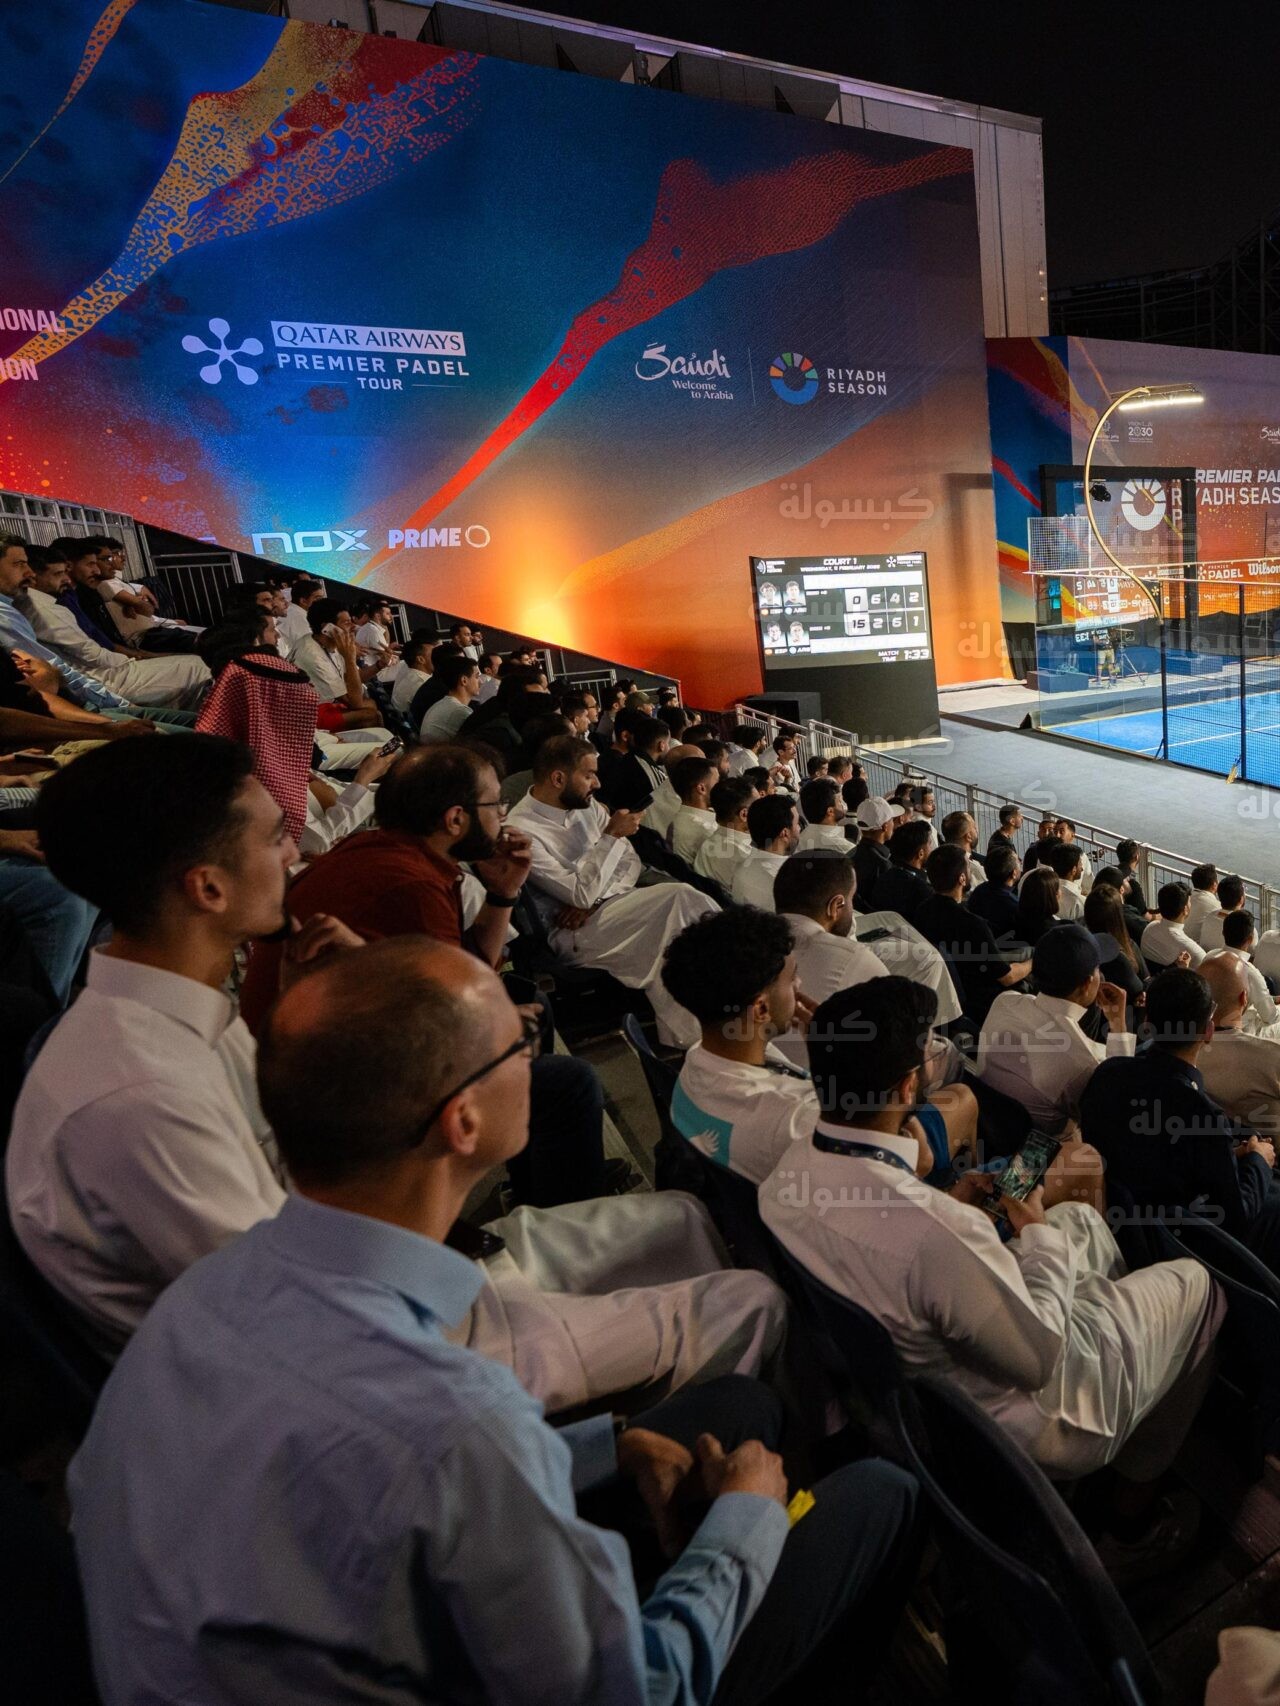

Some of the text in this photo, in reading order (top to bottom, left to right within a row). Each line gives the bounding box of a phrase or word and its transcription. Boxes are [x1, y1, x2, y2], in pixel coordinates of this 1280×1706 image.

[277, 325, 461, 351] QATAR AIRWAYS
[277, 353, 470, 376] PREMIER PADEL
[635, 342, 732, 380] Saudi
[827, 368, 887, 382] RIYADH
[357, 377, 403, 390] TOUR
[672, 380, 717, 391] Welcome
[828, 382, 888, 396] SEASON
[691, 390, 734, 400] to Arabia
[1128, 426, 1153, 437] 2030
[1195, 469, 1252, 484] REMIER
[823, 558, 851, 566] COURT
[1208, 568, 1244, 579] PADEL
[852, 591, 919, 605] 0 6 4 2
[852, 615, 919, 629] 15 2 6 1
[903, 648, 929, 660] 1:33
